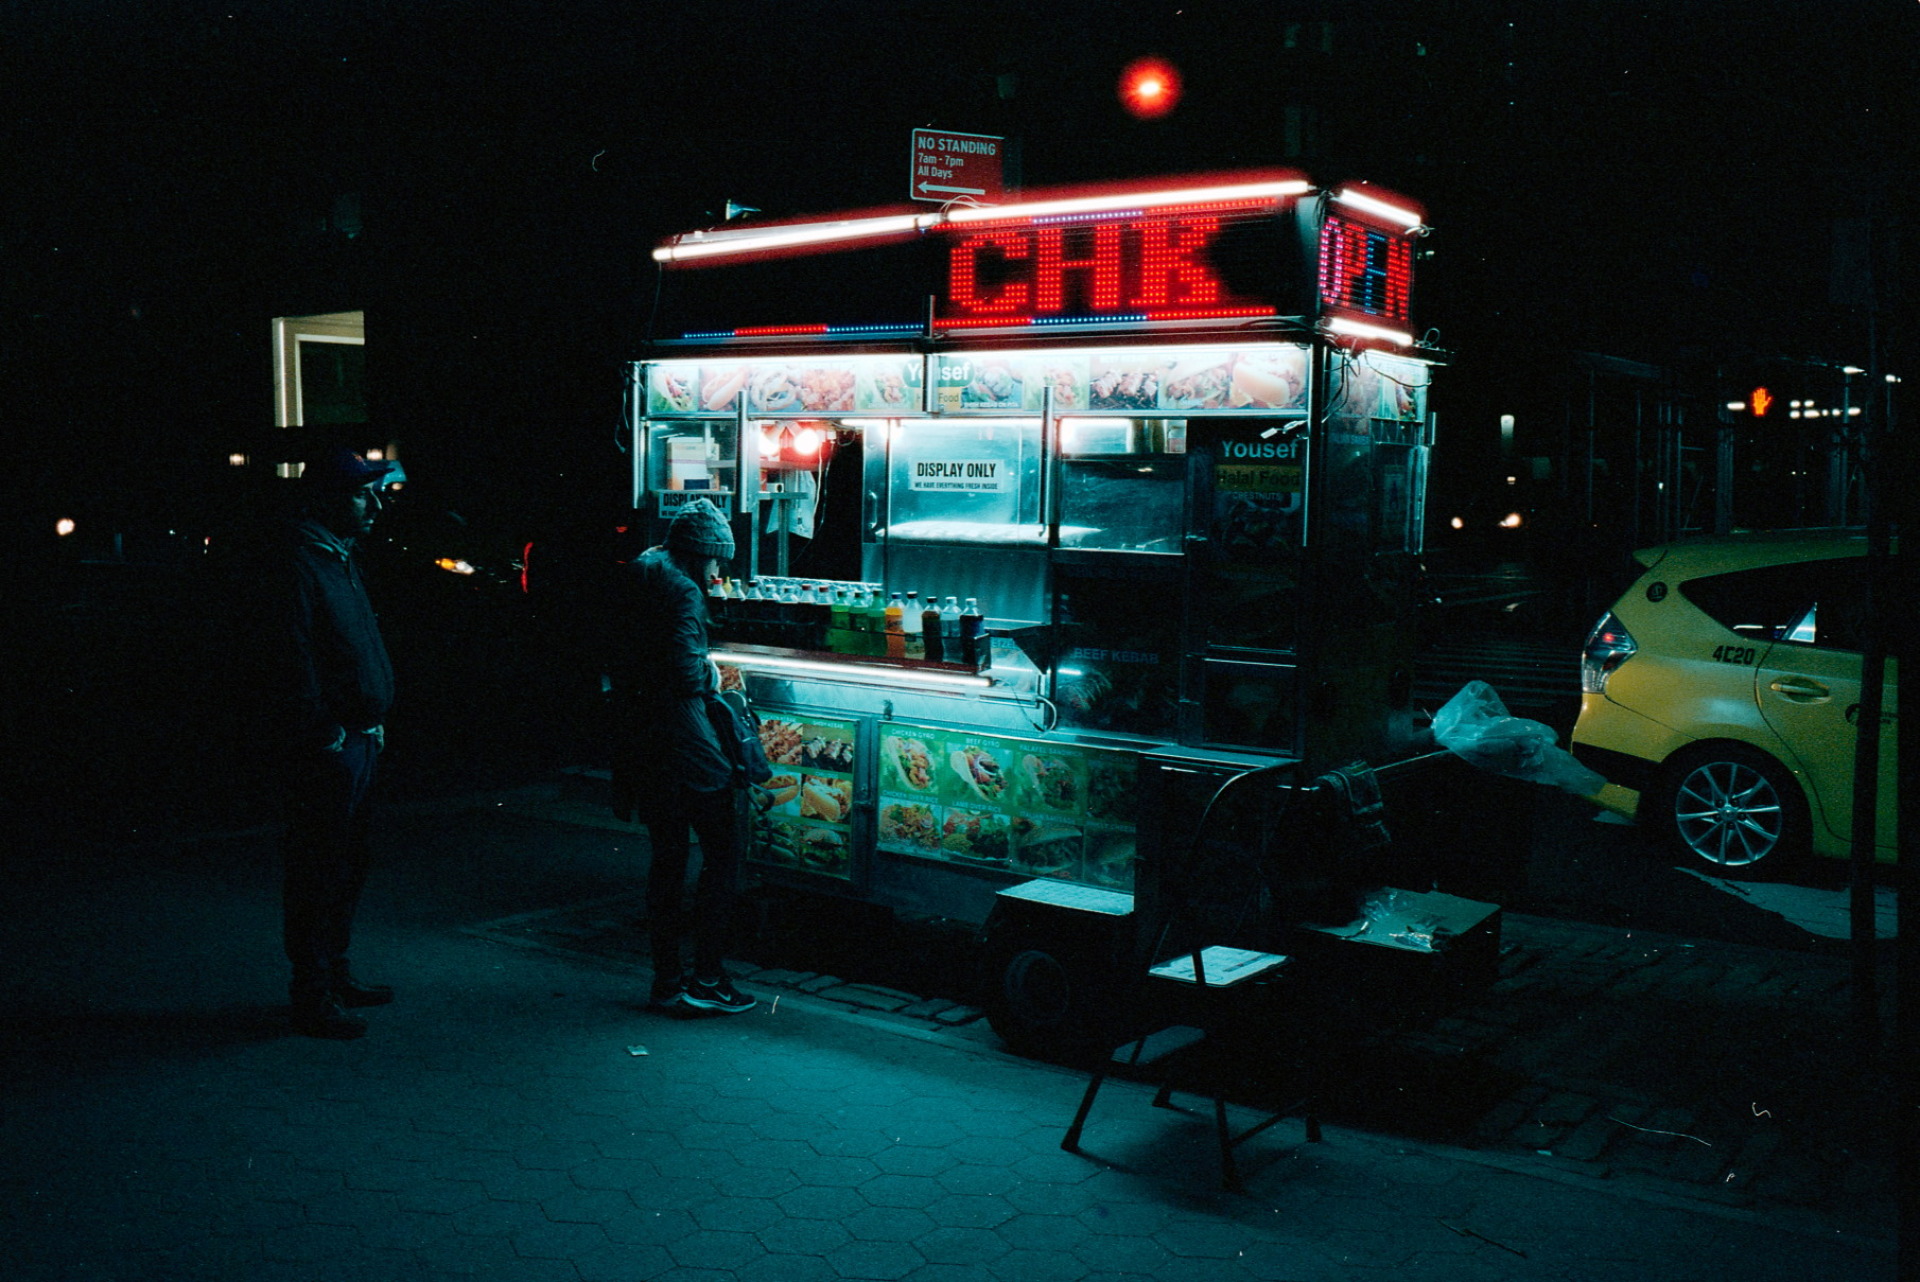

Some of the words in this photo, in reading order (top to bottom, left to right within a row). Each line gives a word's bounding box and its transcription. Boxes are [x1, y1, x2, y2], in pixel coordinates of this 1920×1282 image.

[918, 137, 935, 150] NO
[938, 139, 996, 156] STANDING
[918, 153, 937, 164] 7am
[945, 155, 964, 168] 7pm
[918, 166, 930, 176] All
[931, 167, 953, 180] Days
[1319, 217, 1411, 321] OPEN
[907, 362, 972, 382] Ysef
[1221, 439, 1299, 459] Yousef
[917, 462, 964, 478] DISPLAY
[966, 463, 996, 478] ONLY
[1216, 470, 1254, 485] Halal
[1259, 471, 1299, 487] Food
[1073, 648, 1108, 661] BEEF
[1111, 651, 1160, 665] KEBAB
[1712, 645, 1755, 665] 4C20
